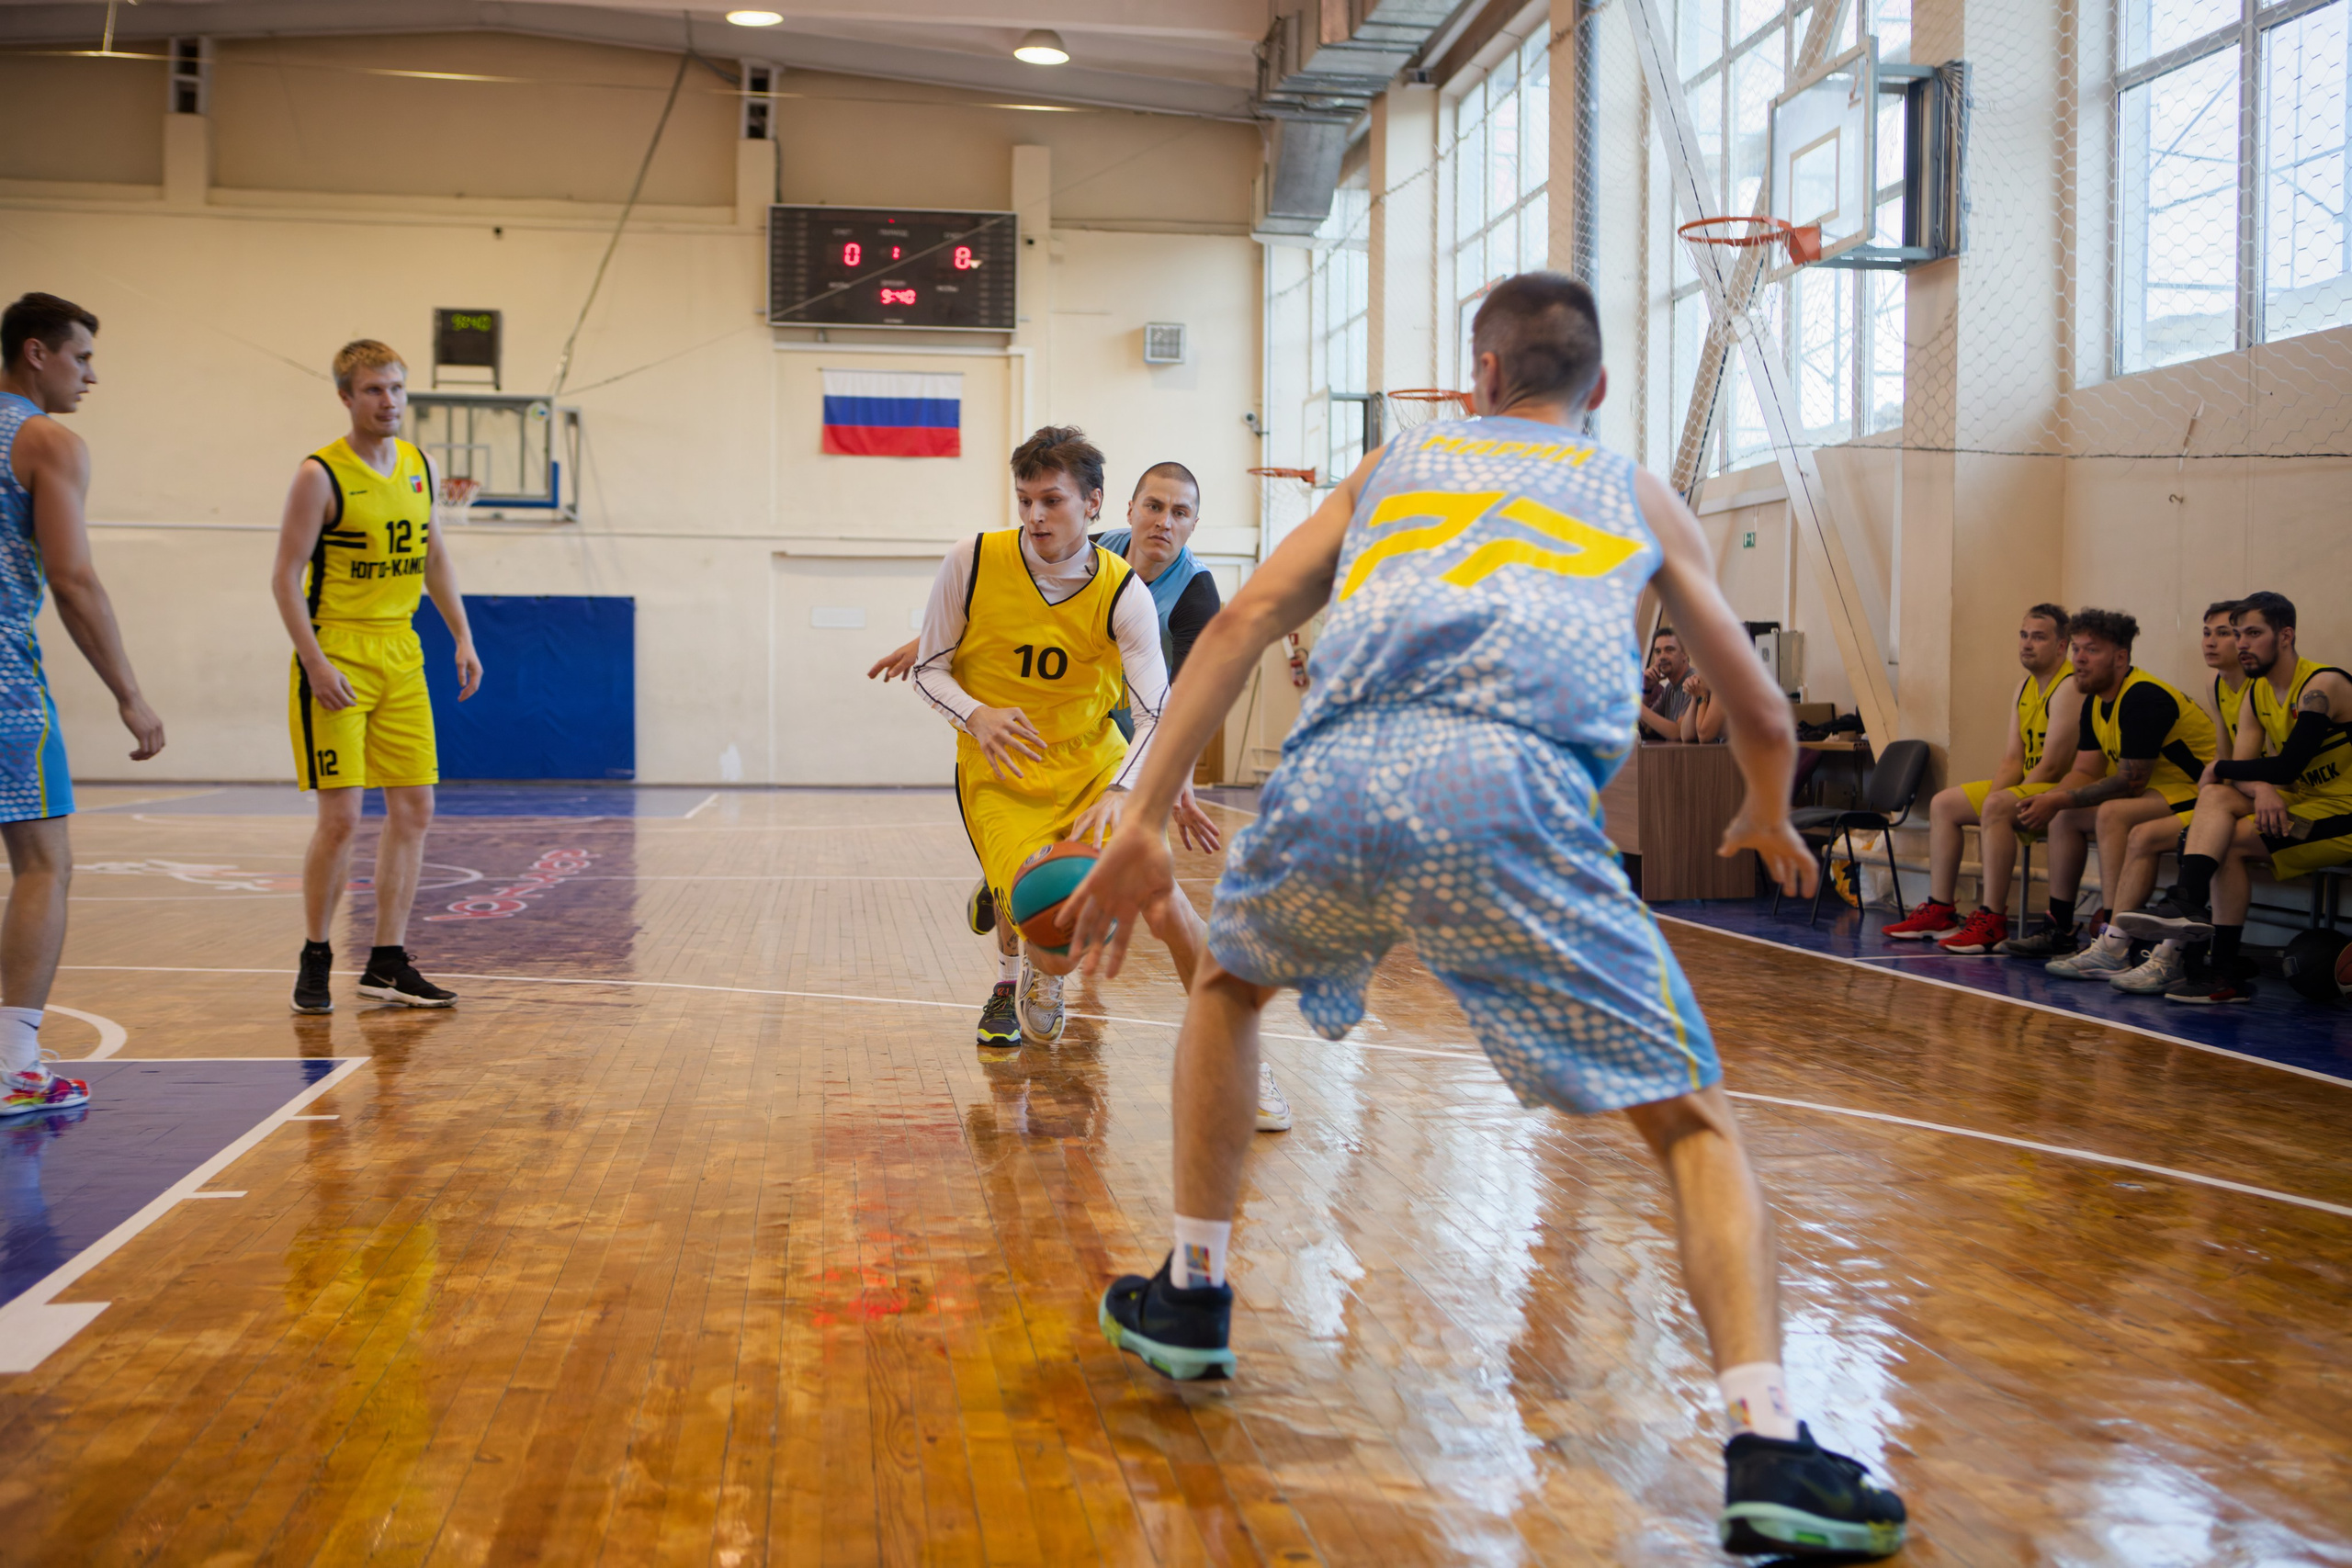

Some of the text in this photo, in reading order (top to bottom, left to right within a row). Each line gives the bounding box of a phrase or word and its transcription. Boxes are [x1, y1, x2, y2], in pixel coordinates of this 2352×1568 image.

[844, 243, 861, 265] 0
[955, 246, 971, 269] 8
[386, 520, 412, 553] 12
[1013, 644, 1068, 680] 10
[318, 750, 338, 776] 12
